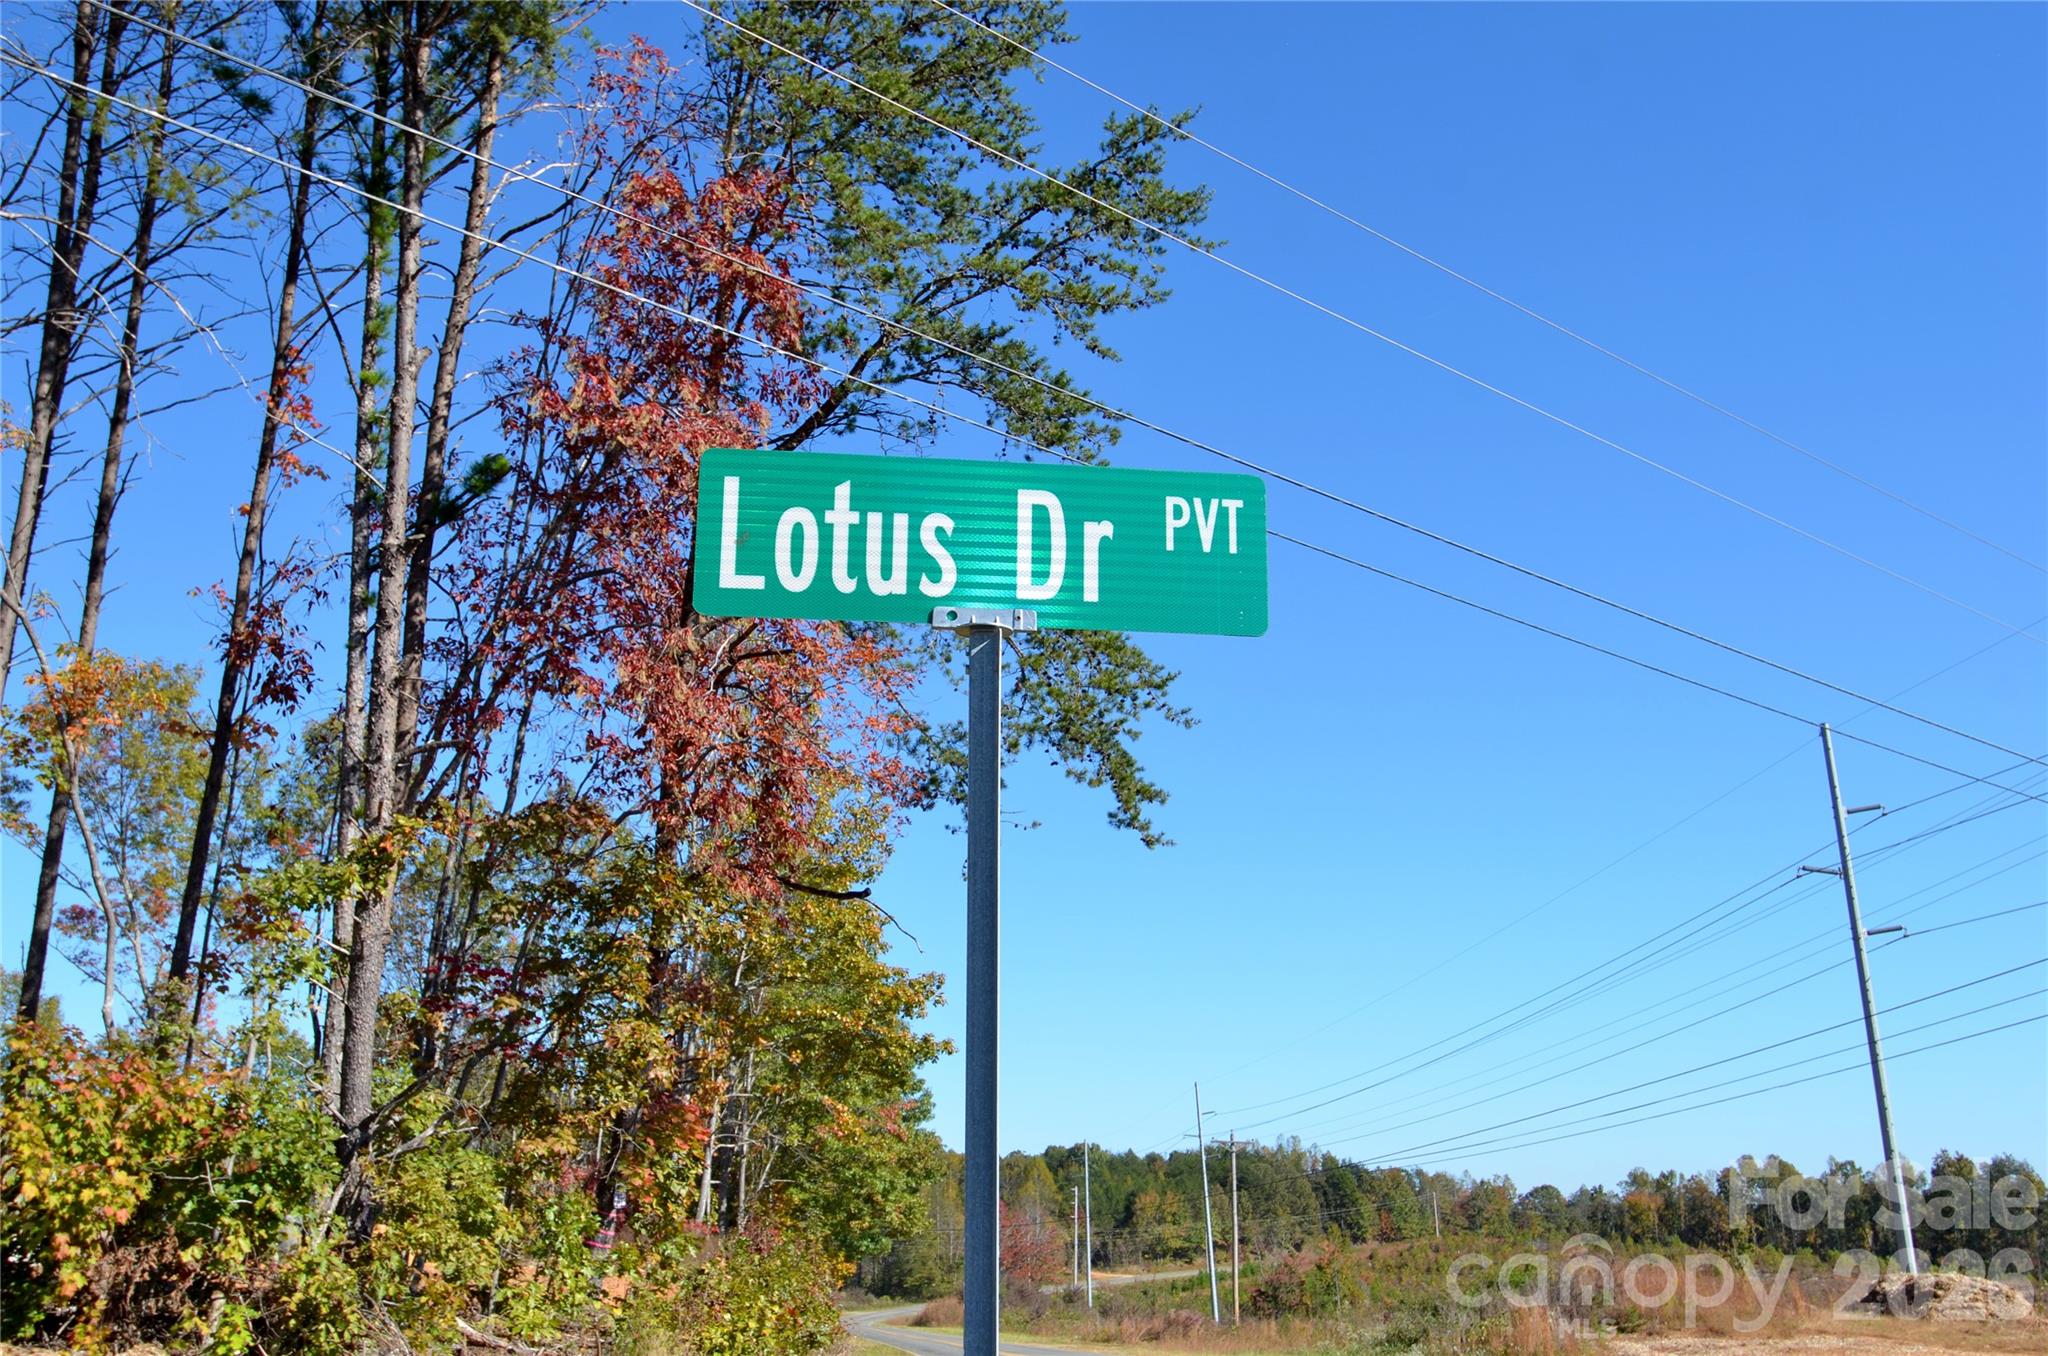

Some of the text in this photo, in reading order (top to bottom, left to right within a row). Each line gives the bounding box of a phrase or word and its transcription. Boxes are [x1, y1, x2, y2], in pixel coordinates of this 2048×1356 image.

[718, 475, 1244, 603] Lotus Dr PVT
